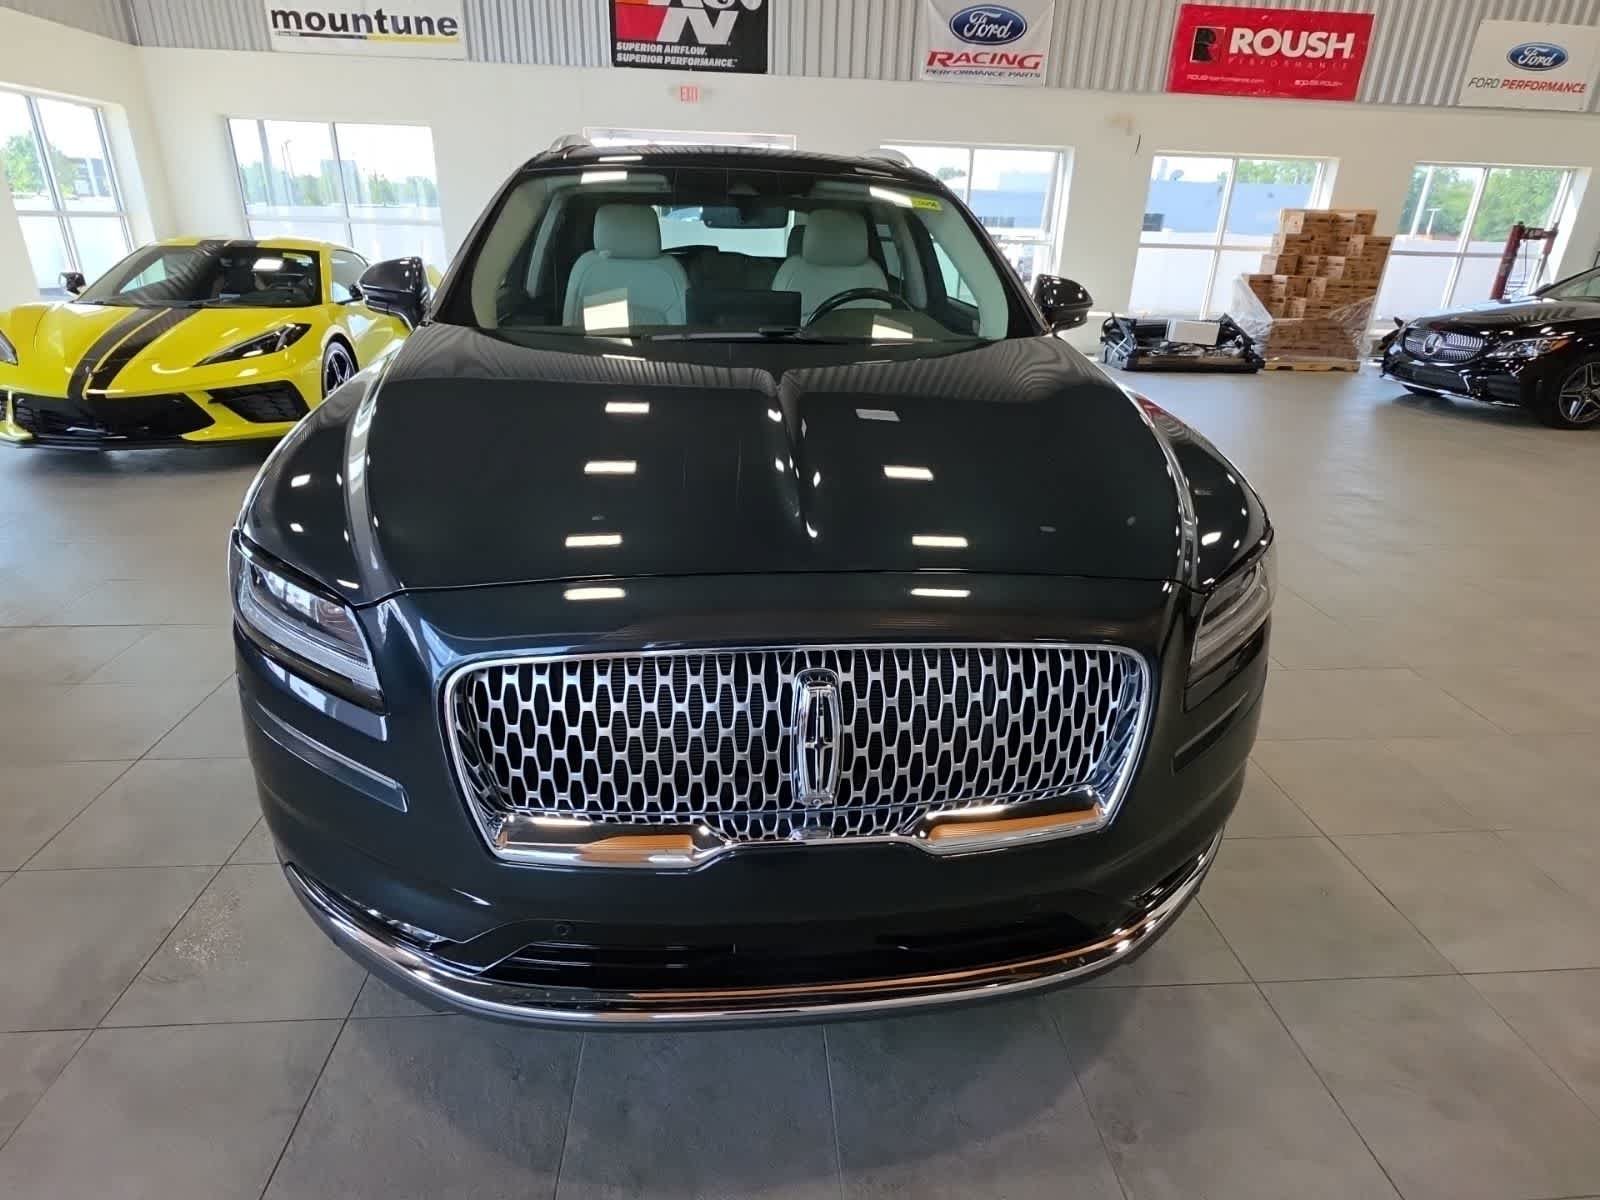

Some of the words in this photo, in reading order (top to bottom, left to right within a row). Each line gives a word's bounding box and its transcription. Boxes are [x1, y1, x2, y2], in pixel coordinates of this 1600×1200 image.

[271, 8, 458, 36] mountune
[962, 9, 1015, 40] Ford
[616, 41, 662, 54] SUPERIOR
[664, 45, 707, 56] AIRFLOW.
[1229, 27, 1355, 60] ROUSH
[616, 53, 662, 65] SUPERIOR
[927, 51, 1043, 69] RACING
[1516, 45, 1559, 67] Ford
[1468, 77, 1499, 89] FORD
[1500, 79, 1588, 94] PERFORMANCE
